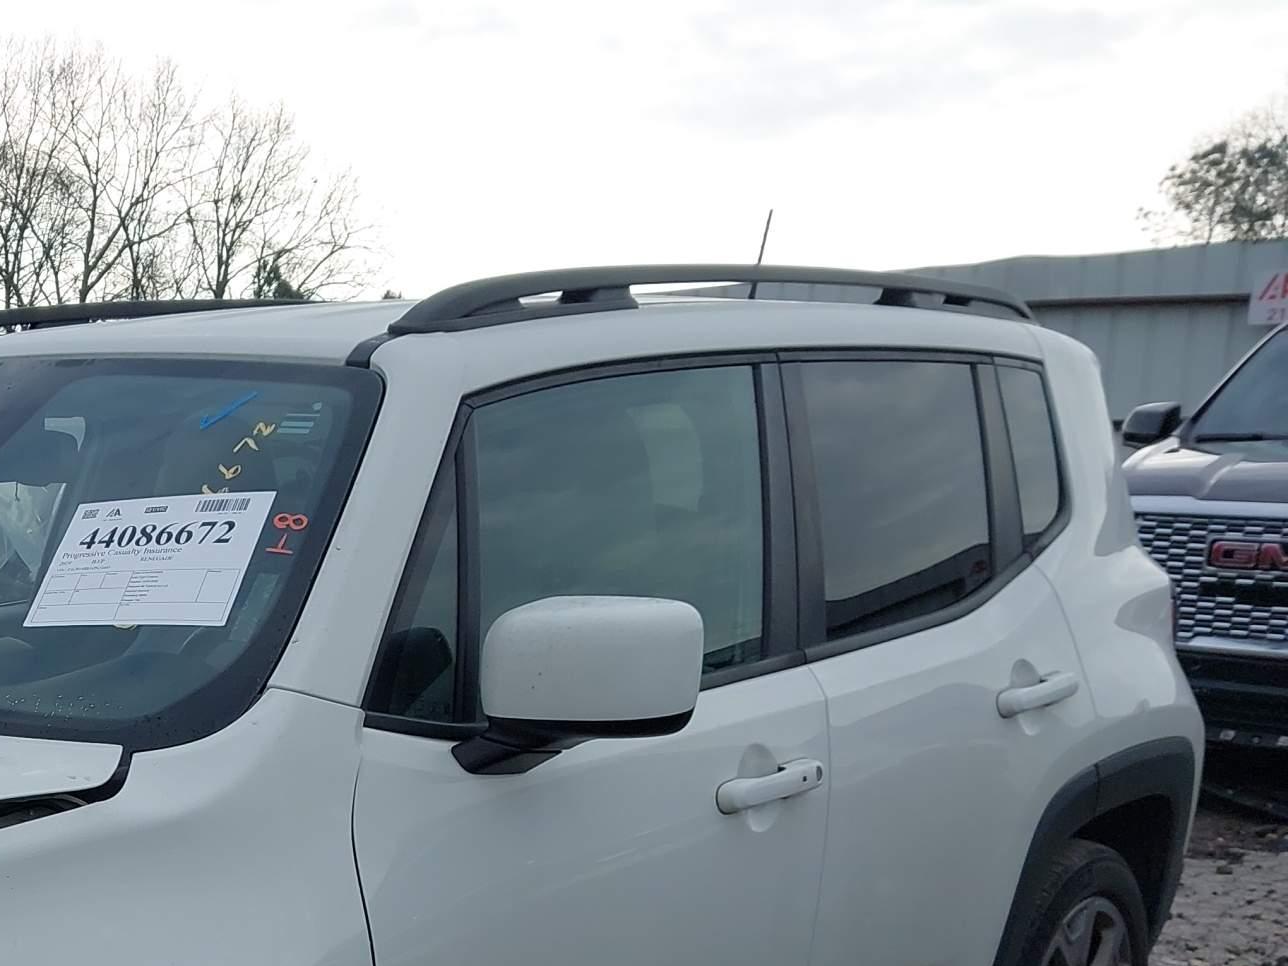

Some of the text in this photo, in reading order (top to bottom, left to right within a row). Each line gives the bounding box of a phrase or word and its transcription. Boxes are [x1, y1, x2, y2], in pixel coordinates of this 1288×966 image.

[79, 520, 236, 550] 44086672
[62, 550, 107, 560] Progressive
[143, 546, 183, 555] Insurance
